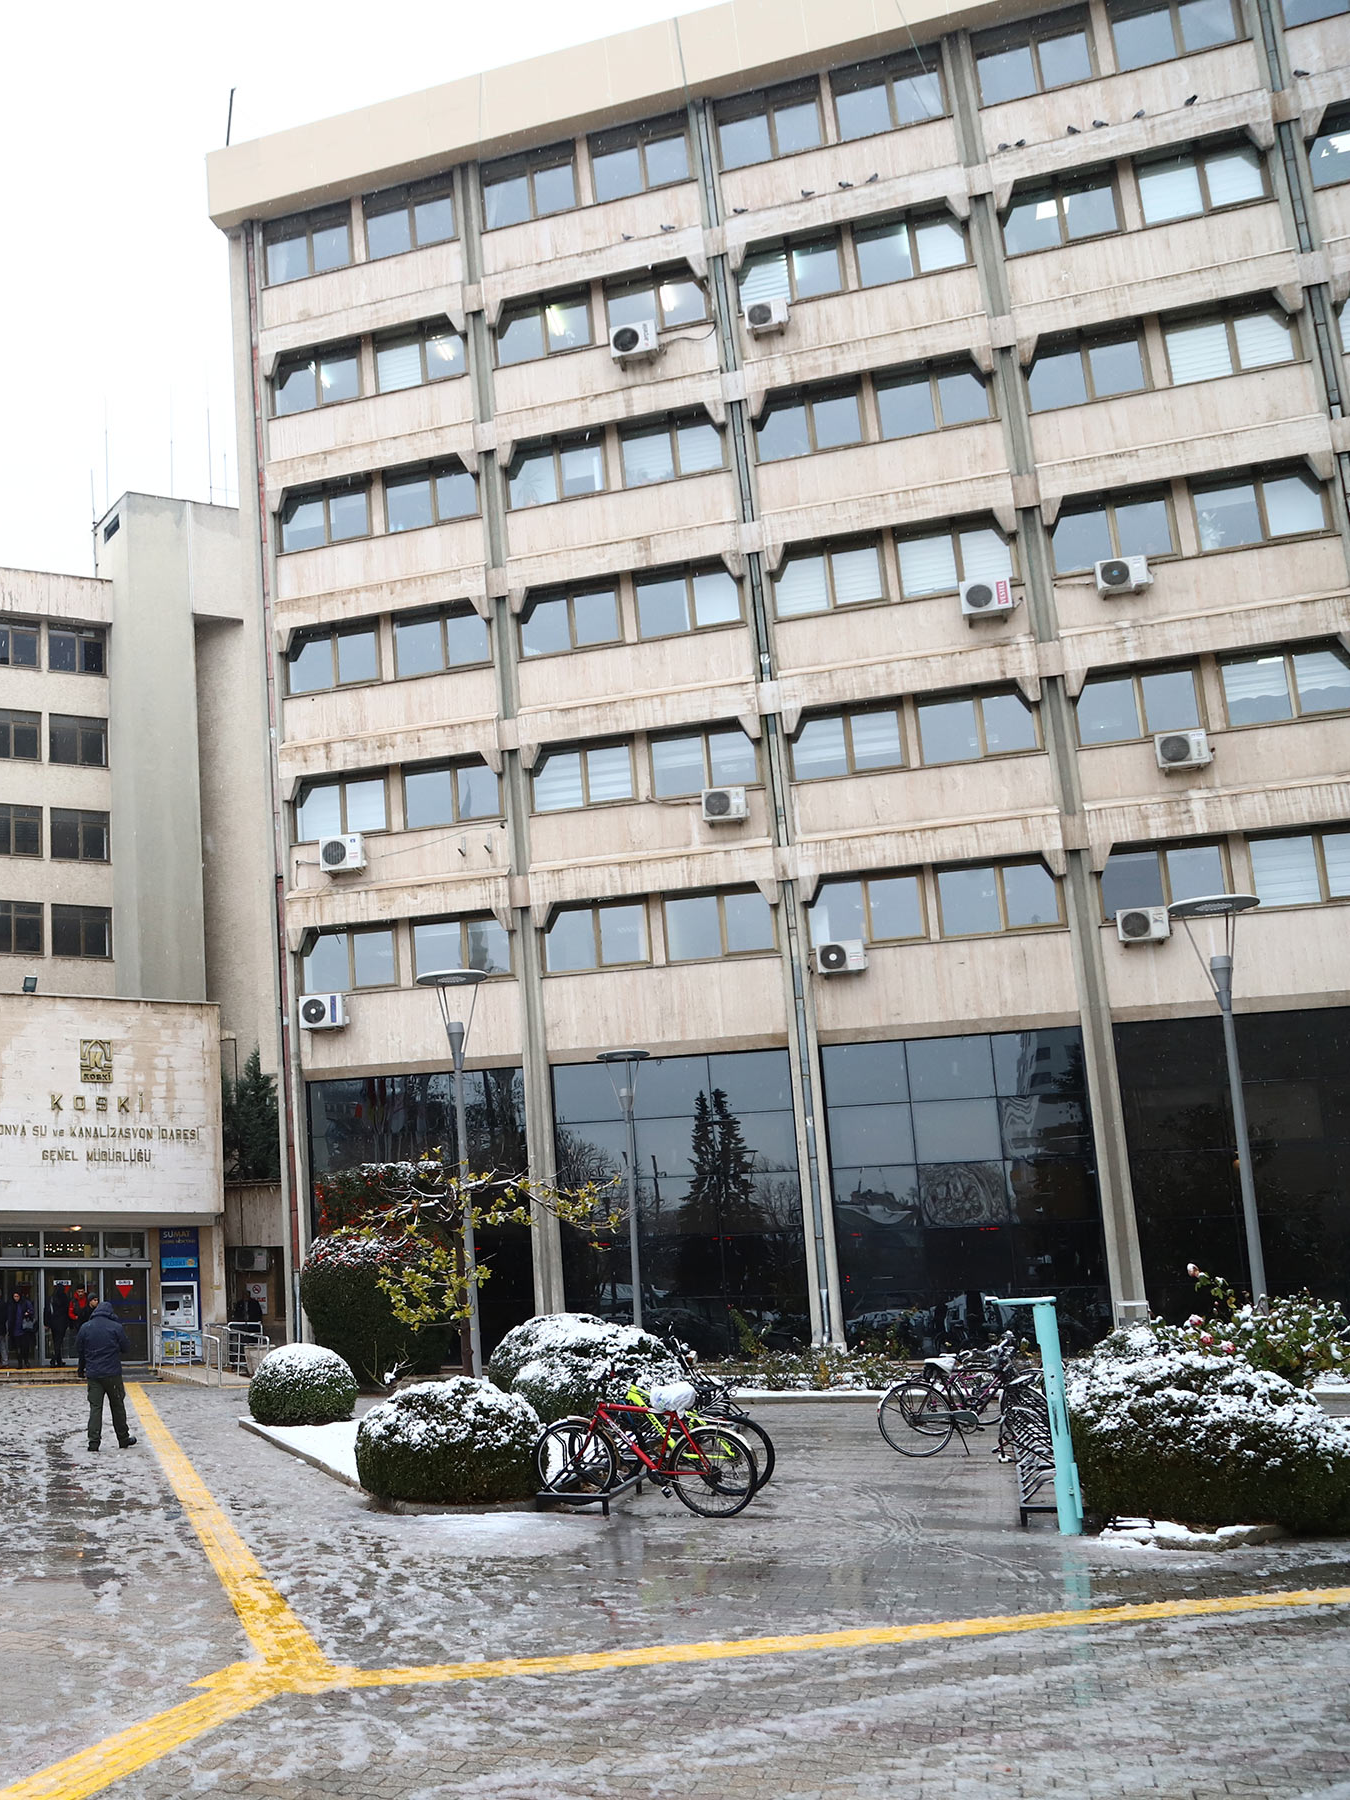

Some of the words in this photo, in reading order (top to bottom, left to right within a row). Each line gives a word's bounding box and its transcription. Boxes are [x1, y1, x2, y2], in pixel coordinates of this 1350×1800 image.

[50, 1092, 144, 1113] KOSKİ
[32, 1125, 47, 1137] SU
[53, 1129, 65, 1137] ve
[70, 1124, 153, 1140] KANALİZASYON
[41, 1149, 79, 1161] GENEL
[86, 1148, 151, 1162] MÜDÜRLÜĞÜ
